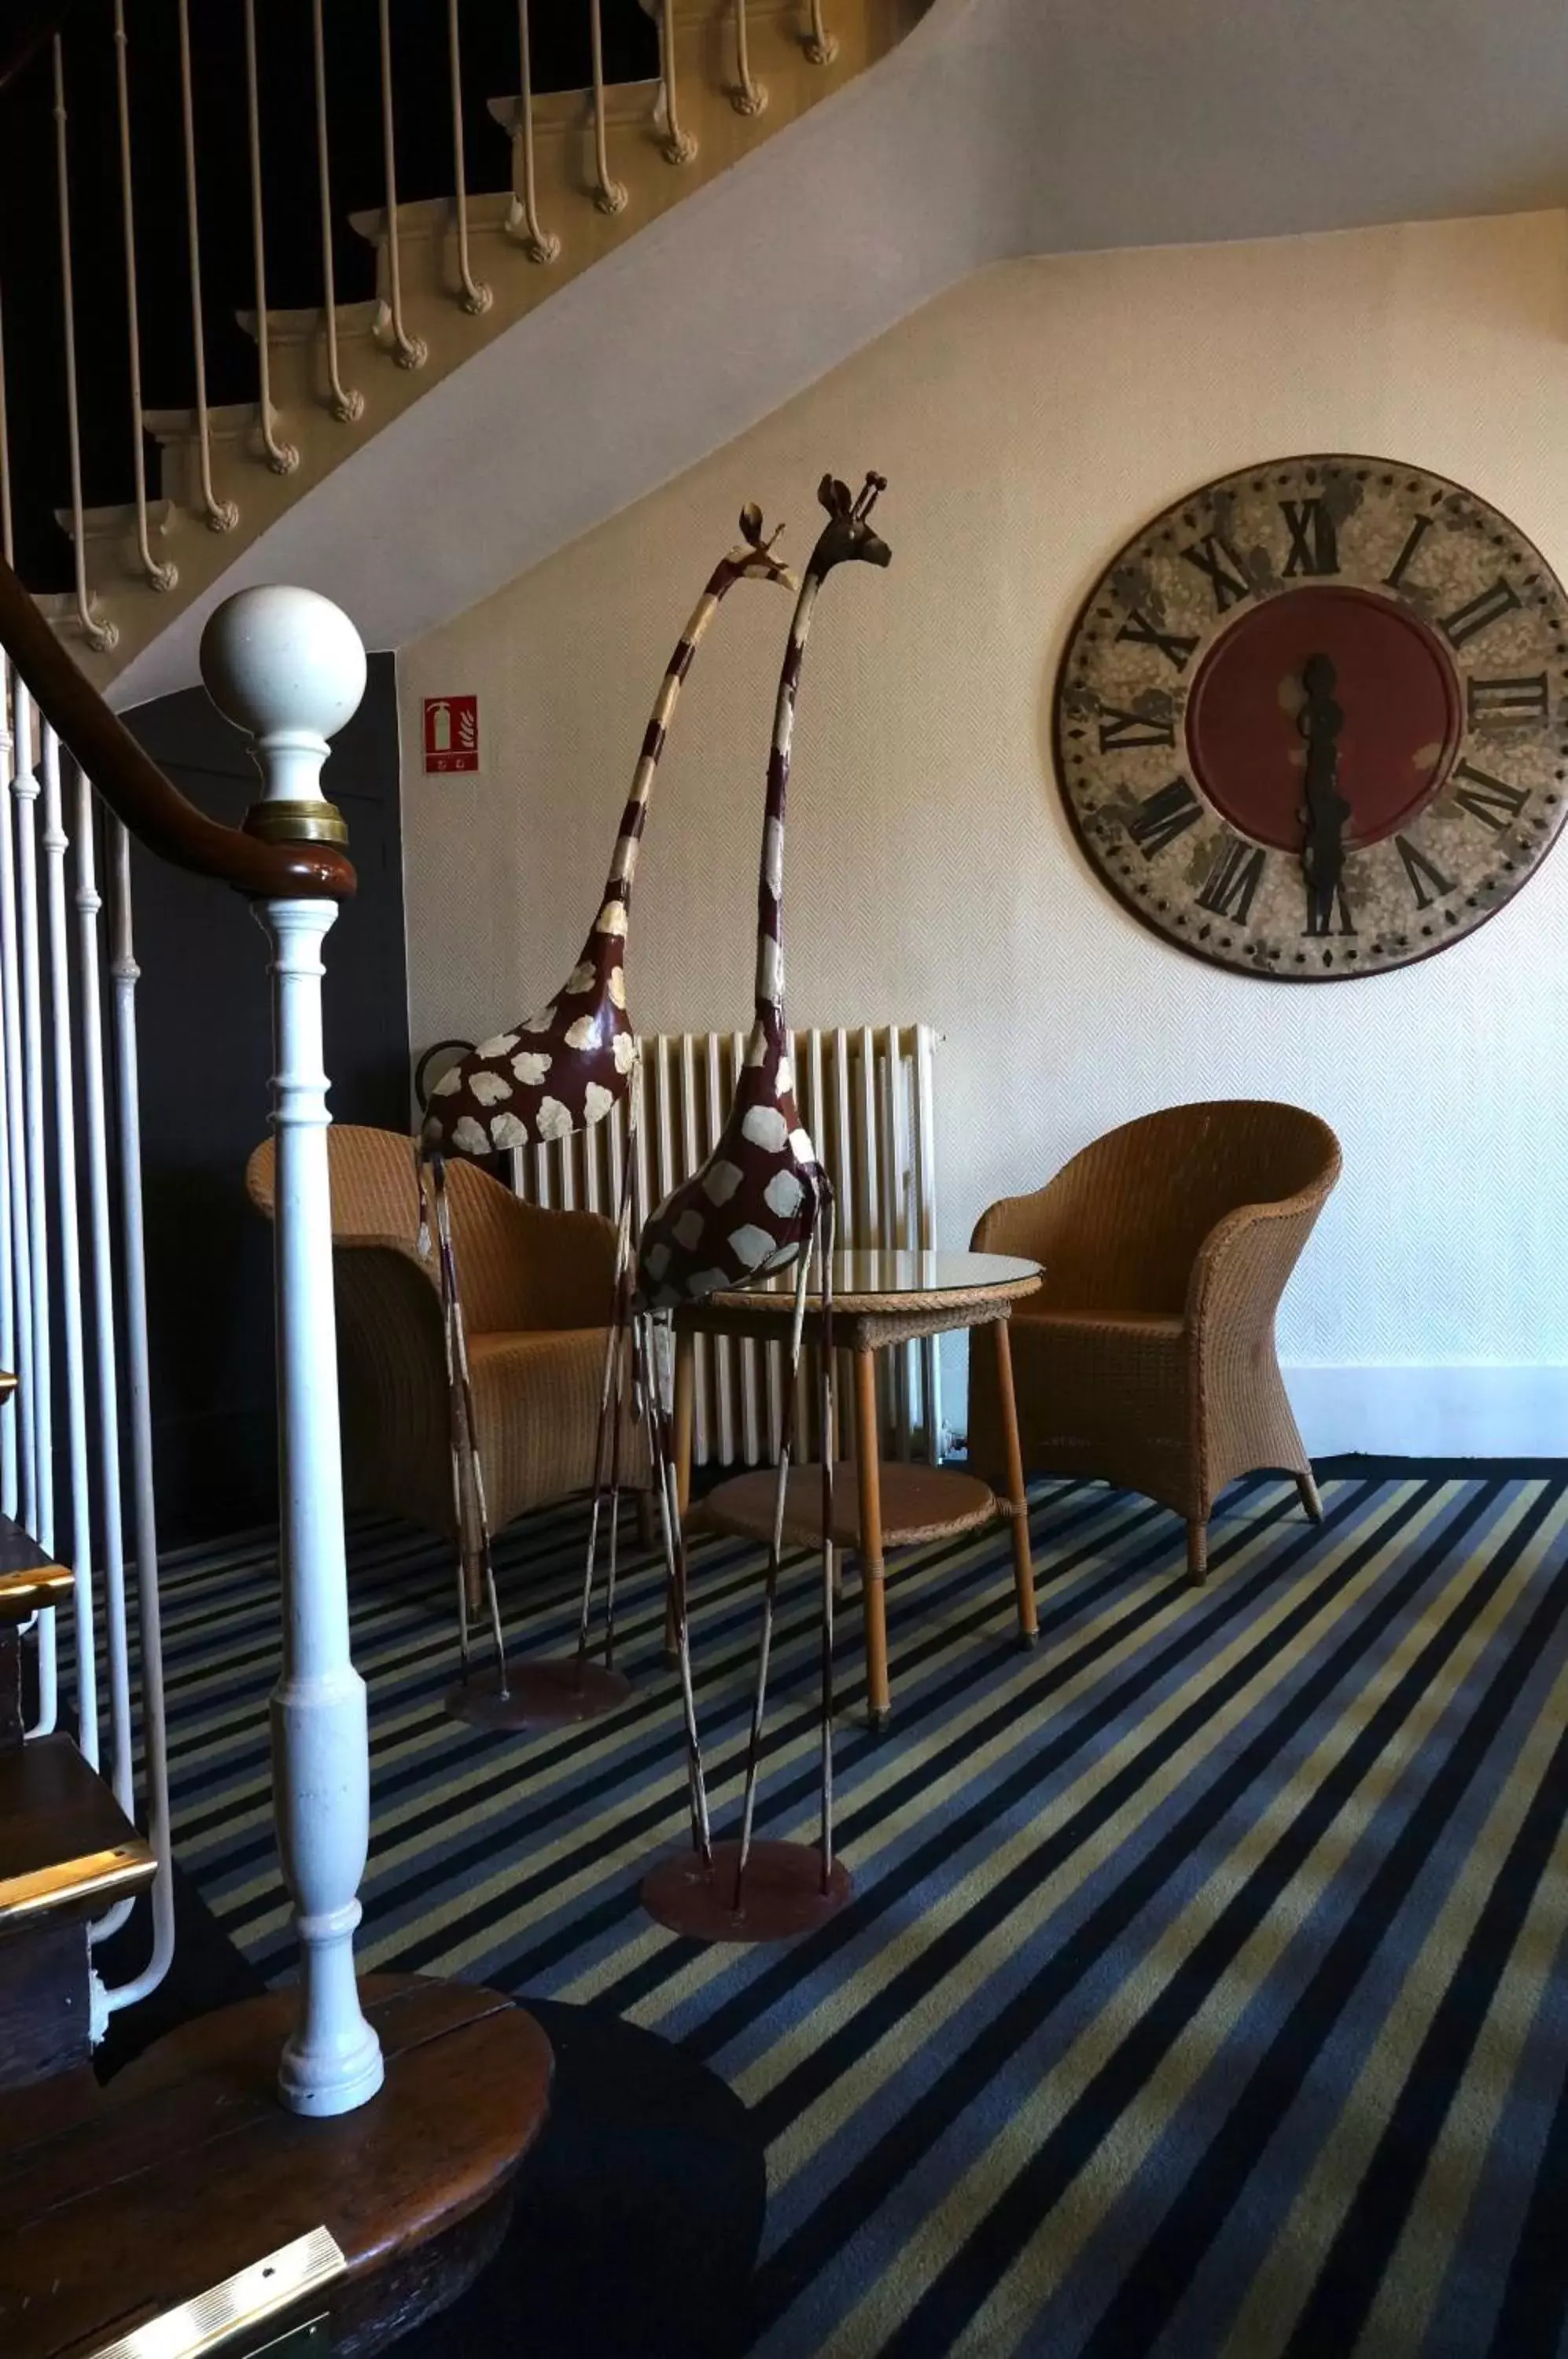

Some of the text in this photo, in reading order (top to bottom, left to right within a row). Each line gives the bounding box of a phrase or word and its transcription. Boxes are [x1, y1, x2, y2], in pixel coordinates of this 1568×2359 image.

[1279, 499, 1340, 577] XII
[1382, 513, 1434, 589] I
[1115, 608, 1201, 674] X
[1436, 576, 1522, 651] II
[1467, 672, 1548, 734] III
[1452, 757, 1531, 831] IV
[1395, 834, 1457, 910] V
